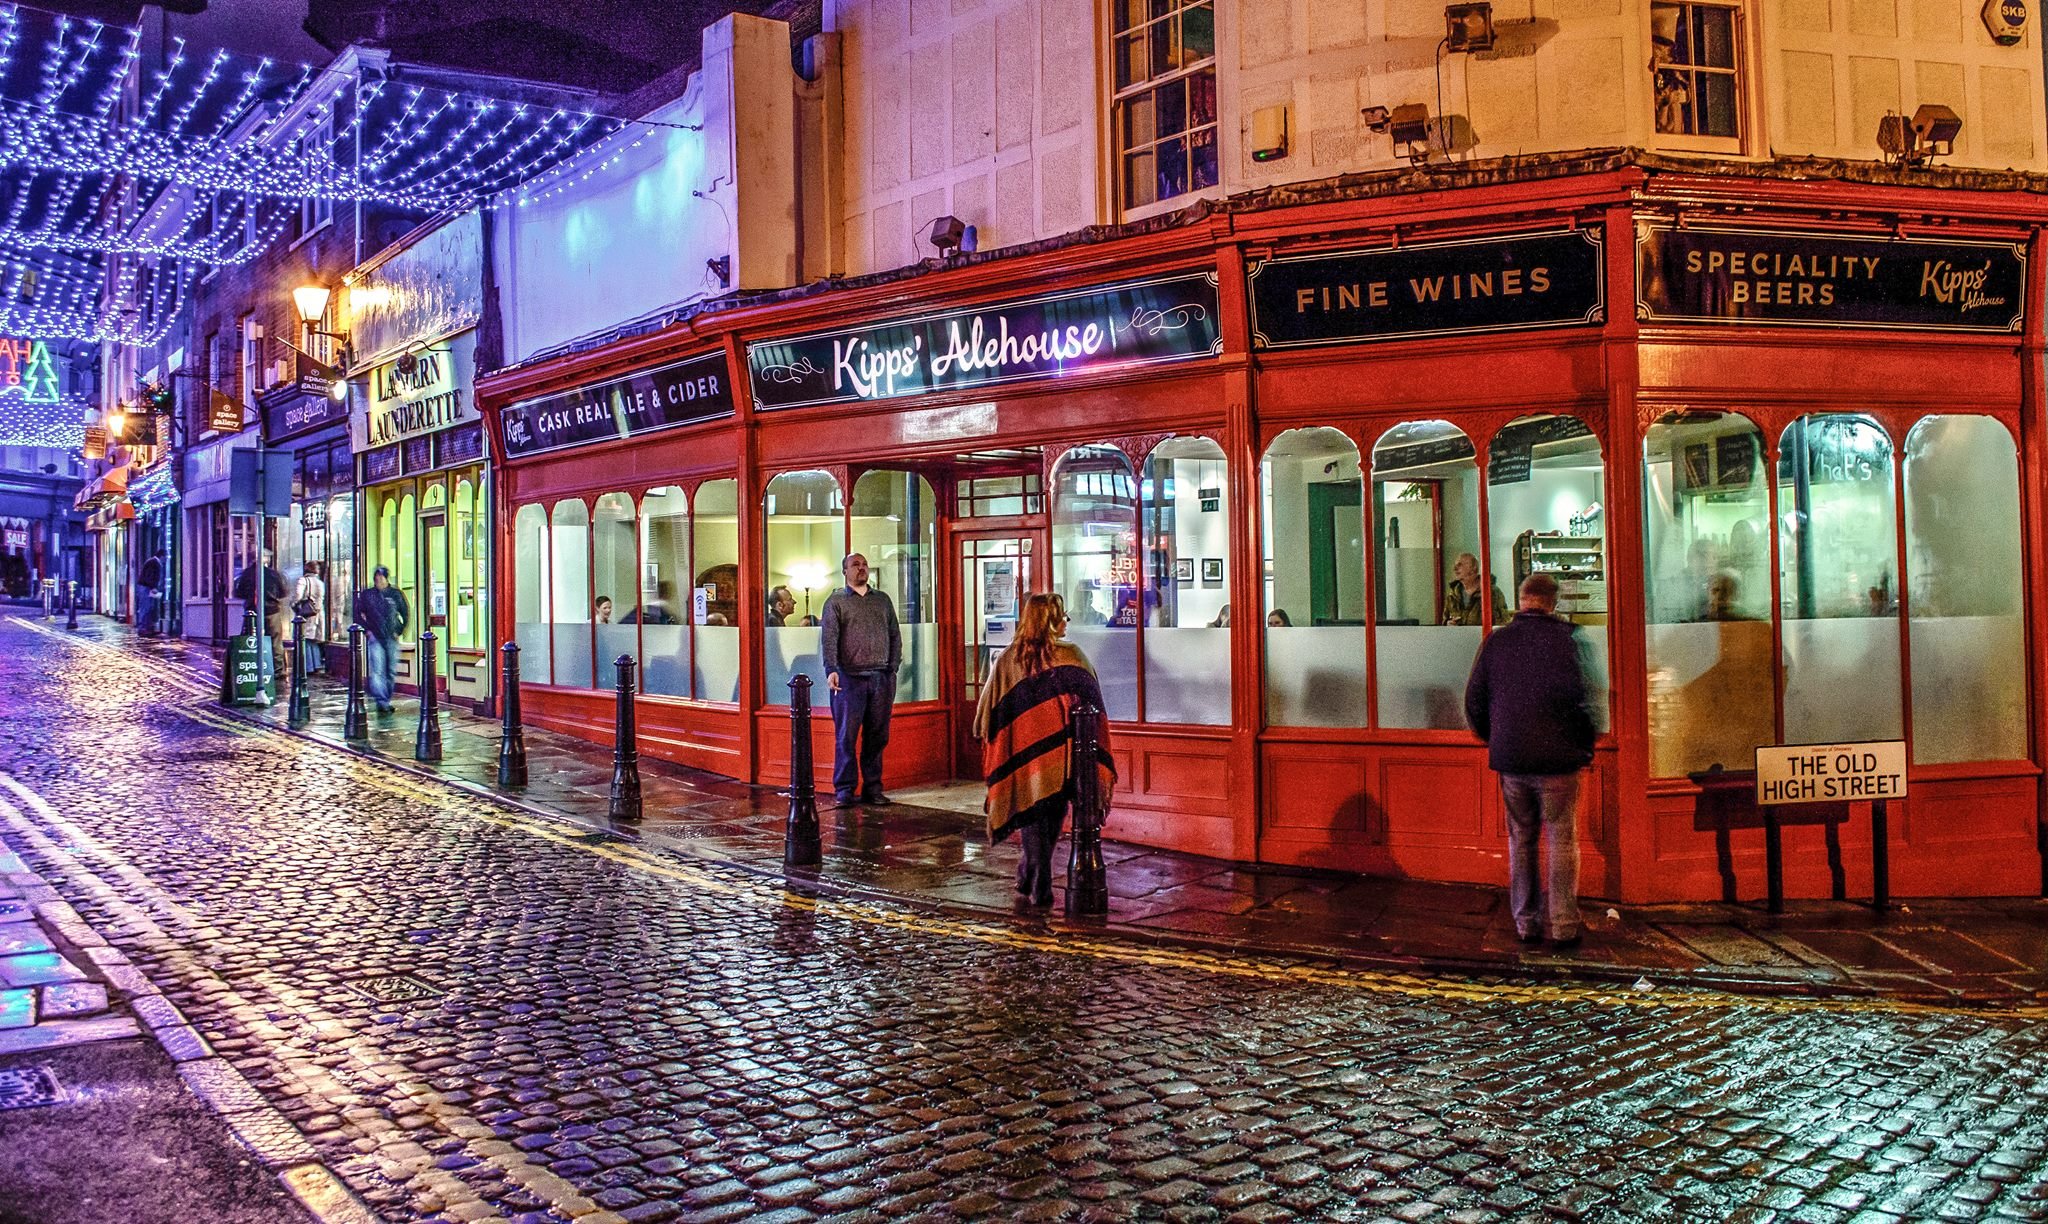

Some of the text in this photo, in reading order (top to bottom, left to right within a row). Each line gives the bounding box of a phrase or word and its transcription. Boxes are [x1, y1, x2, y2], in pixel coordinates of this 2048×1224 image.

[2002, 6, 2025, 17] SKB
[1687, 250, 1880, 279] SPECIALITY
[1296, 267, 1551, 313] FINE WINES
[1919, 259, 1992, 303] Kipps'
[1732, 281, 1834, 305] BEERS
[1961, 291, 2006, 313] Alehouse
[833, 315, 1103, 398] Kipps' Alehouse
[301, 382, 330, 393] gallery
[304, 375, 328, 384] space
[216, 411, 237, 419] space
[285, 396, 328, 429] space gallery
[538, 375, 720, 433] CASK REAL ALE & CIDER
[213, 419, 239, 428] gallery
[365, 388, 464, 445] LAUNDERETTE
[432, 485, 438, 506] 9
[7, 532, 27, 546] SALE
[239, 661, 268, 671] spae
[236, 673, 272, 685] galley
[1787, 753, 1877, 776] THE OLD
[1764, 774, 1900, 800] HIGH STREET
